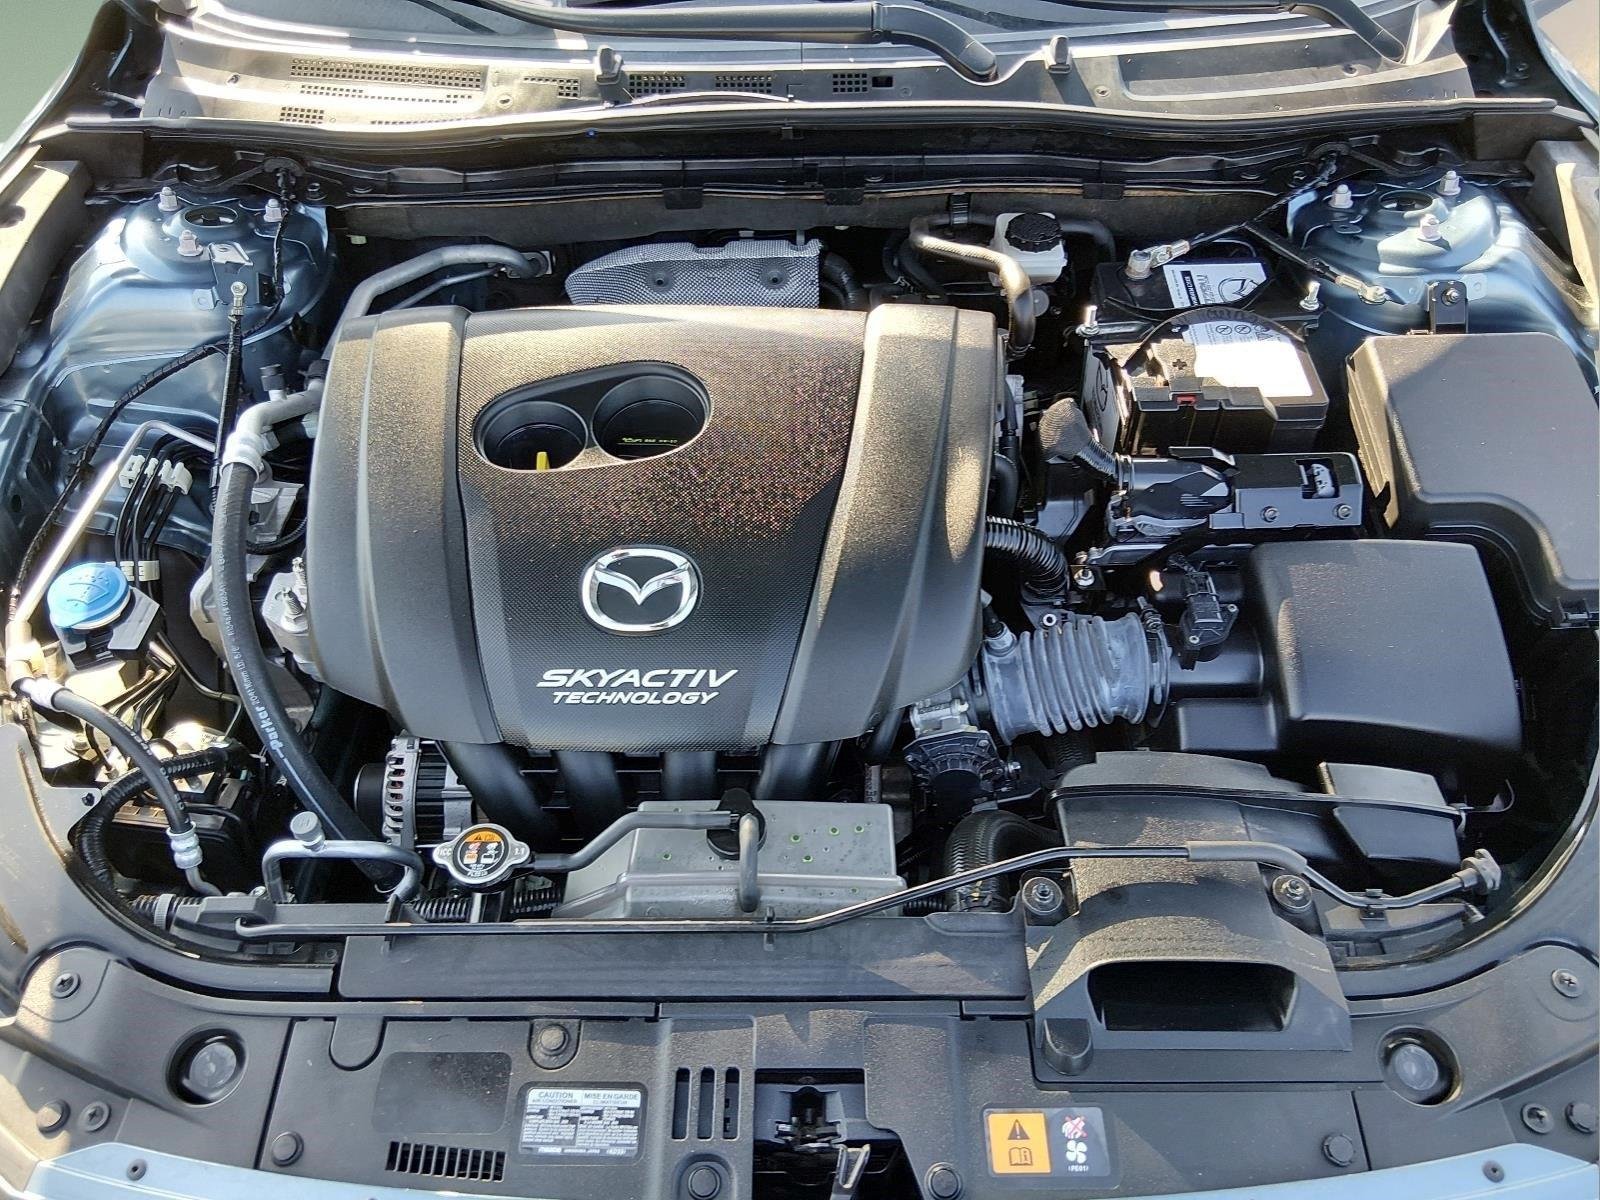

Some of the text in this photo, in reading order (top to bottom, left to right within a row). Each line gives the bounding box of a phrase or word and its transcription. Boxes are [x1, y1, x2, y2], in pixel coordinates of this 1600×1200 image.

[536, 668, 739, 688] SKYACTIV
[552, 691, 719, 705] TECHNOLOGY
[255, 705, 284, 751] Parker
[538, 1091, 574, 1099] CAUTION
[584, 1092, 601, 1100] MISE
